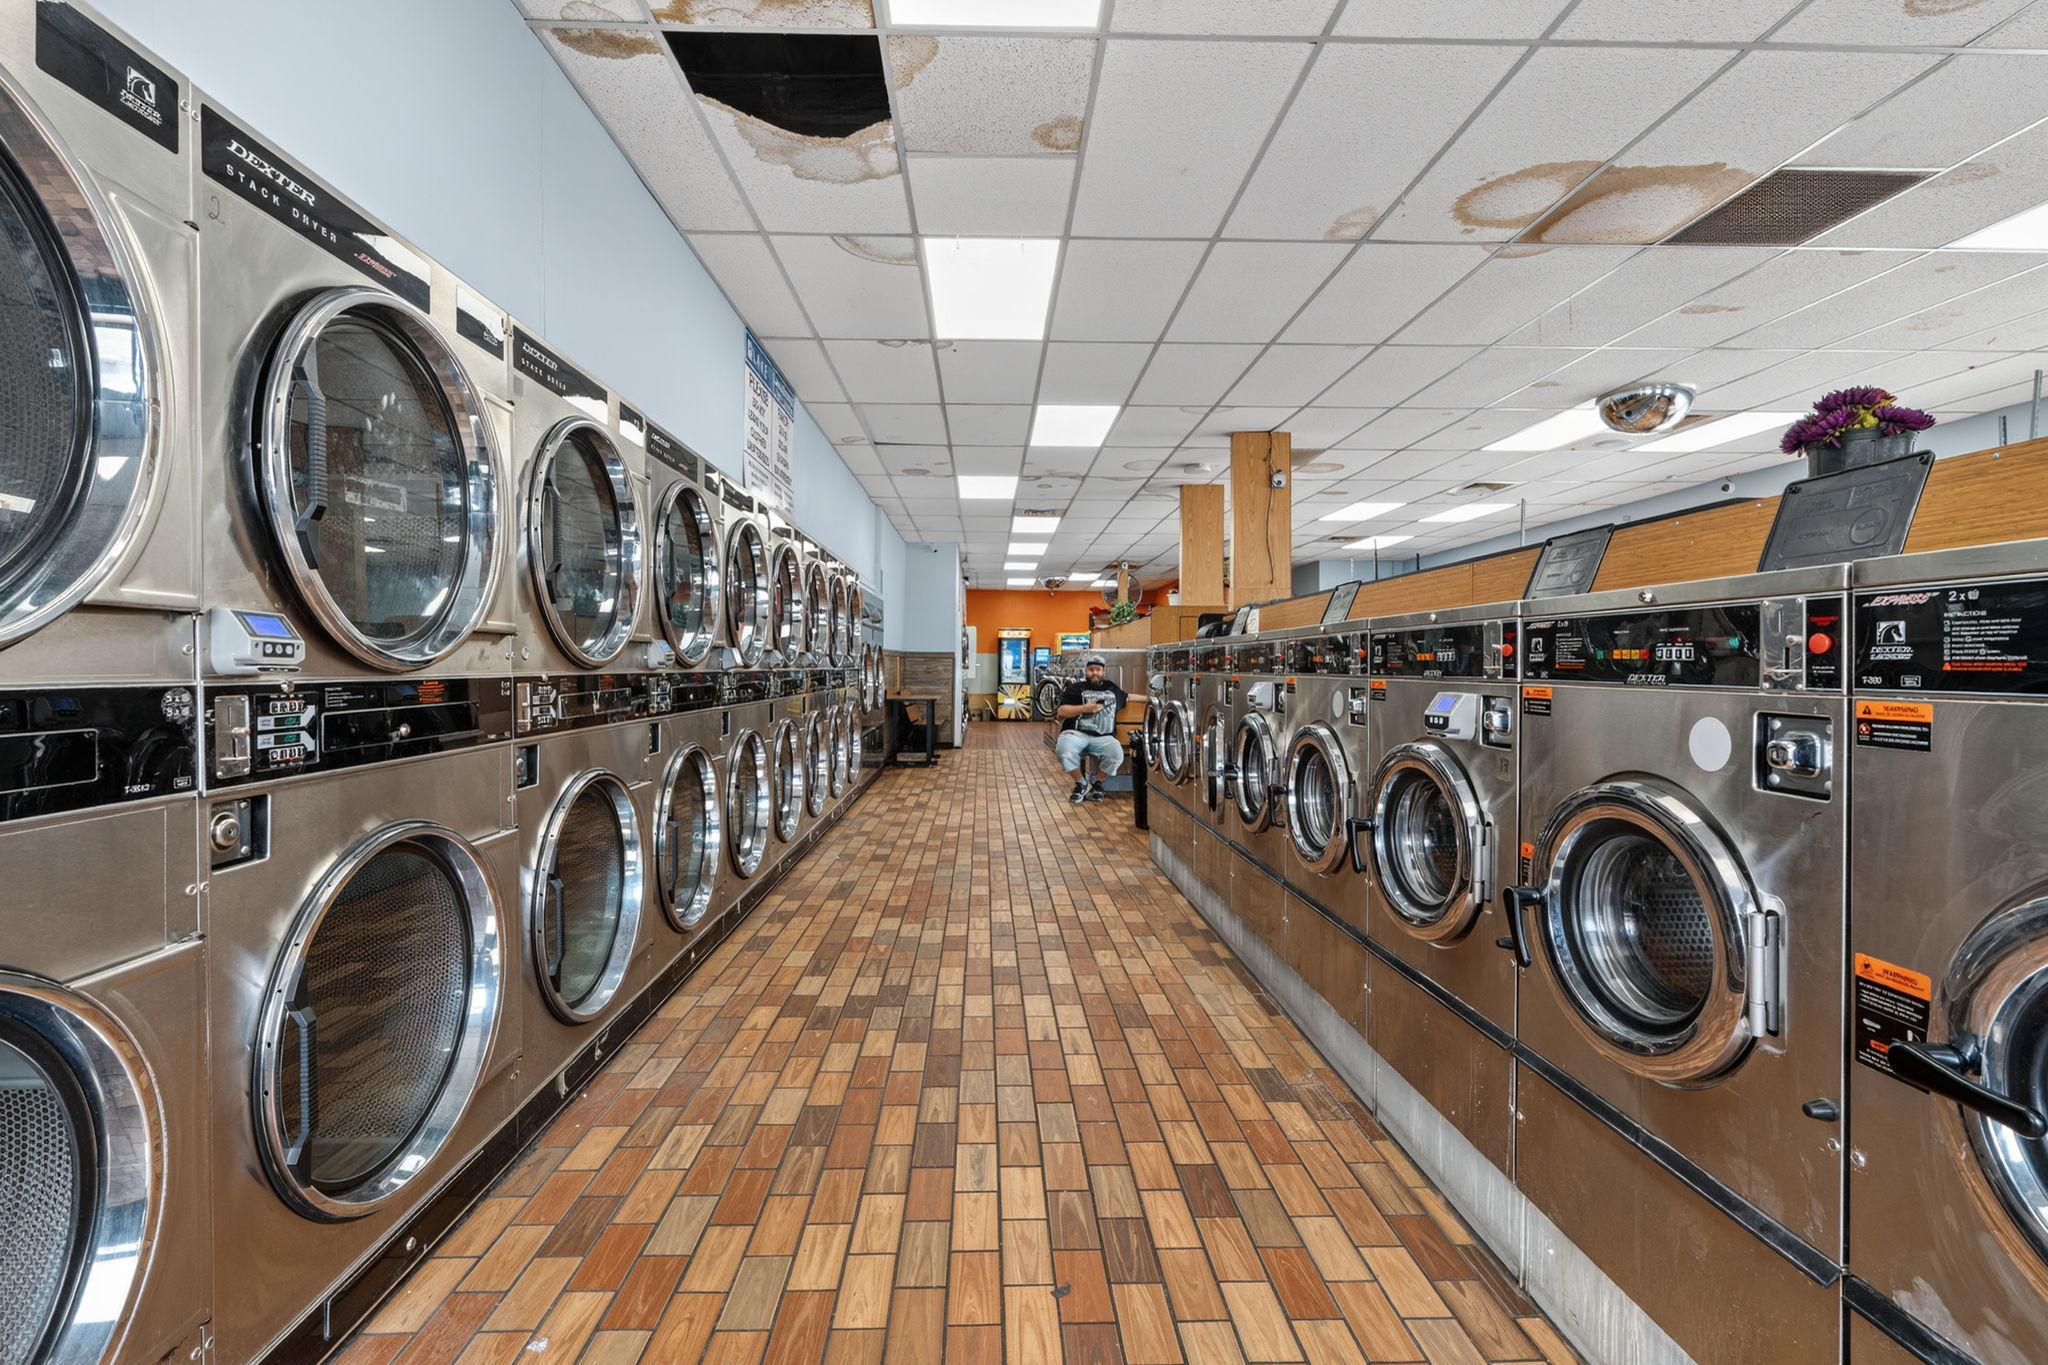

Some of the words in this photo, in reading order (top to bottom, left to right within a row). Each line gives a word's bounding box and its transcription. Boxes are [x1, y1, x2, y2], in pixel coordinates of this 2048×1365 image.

[226, 139, 315, 207] DEXTER
[226, 164, 280, 207] STACK
[292, 207, 337, 243] DRYER
[522, 342, 558, 371] DEXTER
[1948, 590, 1957, 602] 2
[1959, 593, 1966, 601] x
[1627, 674, 1666, 684] DEXTER
[1882, 968, 1918, 987] WARNING
